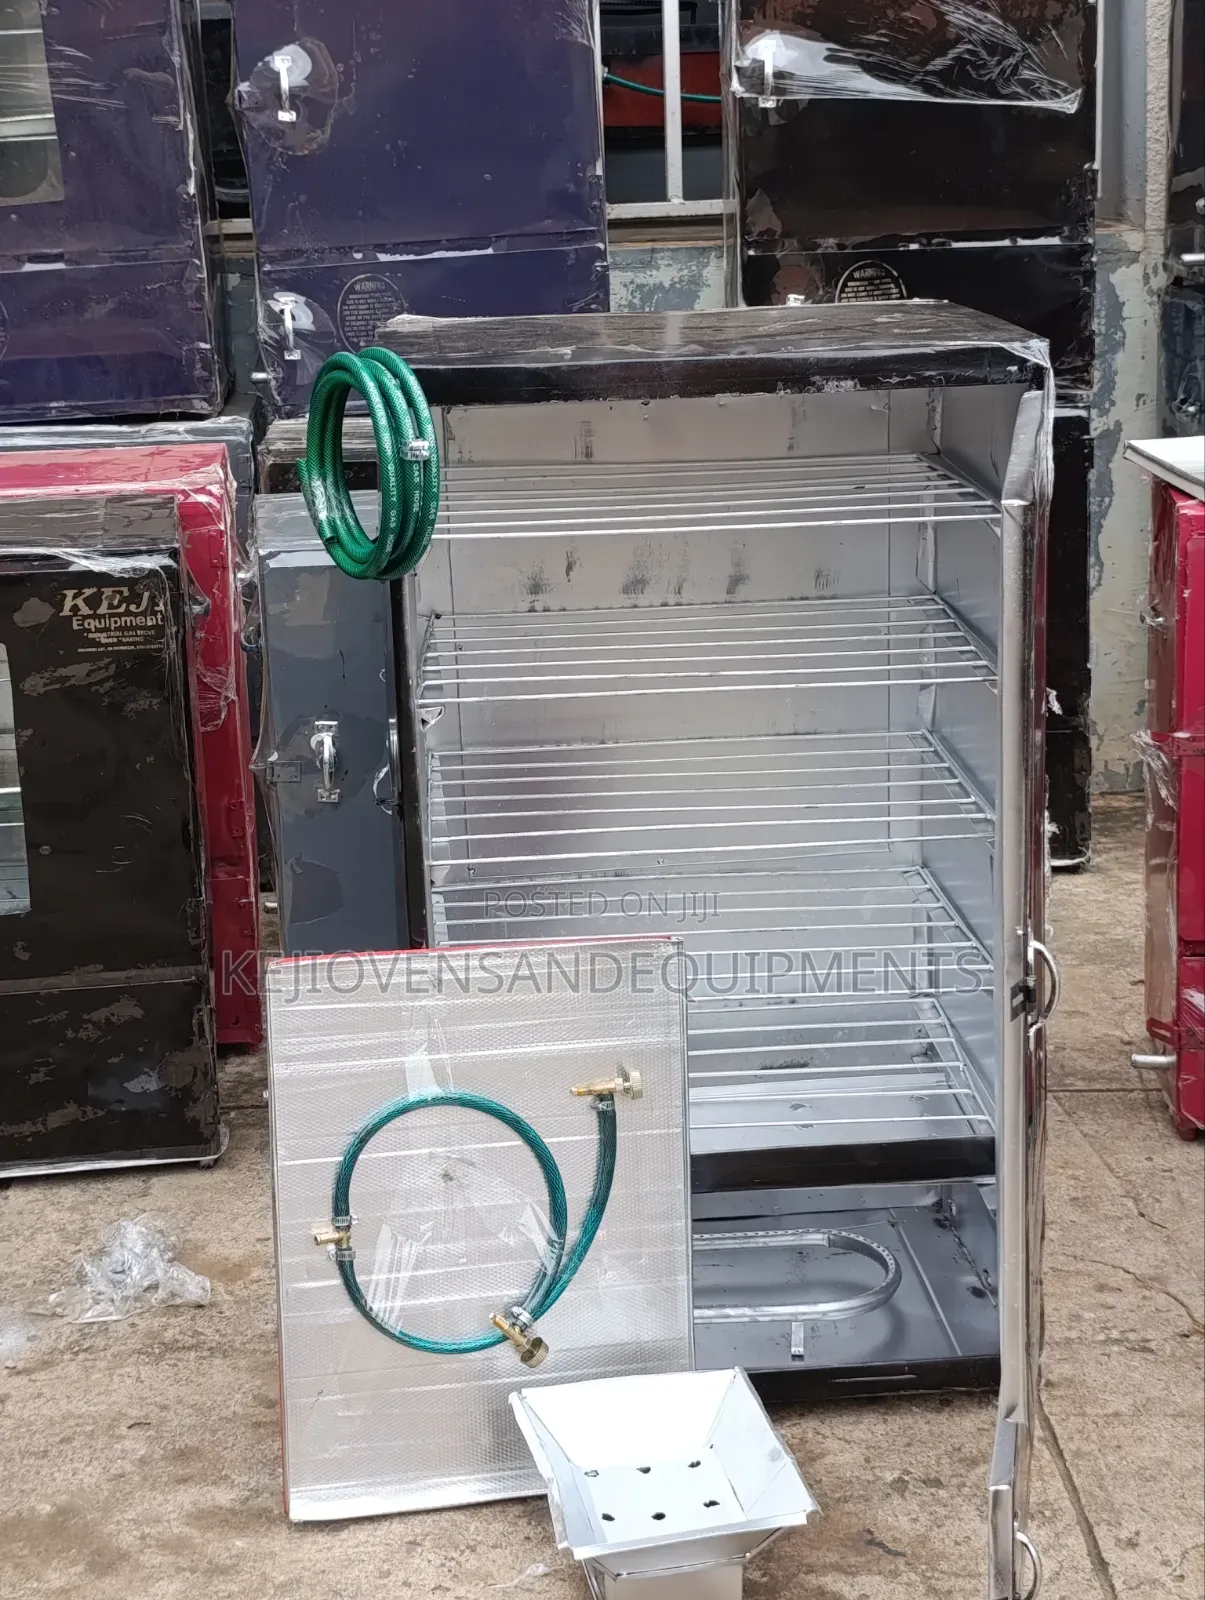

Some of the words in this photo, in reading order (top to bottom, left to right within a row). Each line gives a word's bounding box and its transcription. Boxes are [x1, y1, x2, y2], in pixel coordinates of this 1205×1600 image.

[388, 463, 397, 501] QUALITY
[430, 454, 438, 492] QUALITY
[429, 501, 437, 520] GAS
[386, 534, 394, 552] HOSE
[422, 526, 433, 545] HOSE
[72, 612, 164, 632] Equipment
